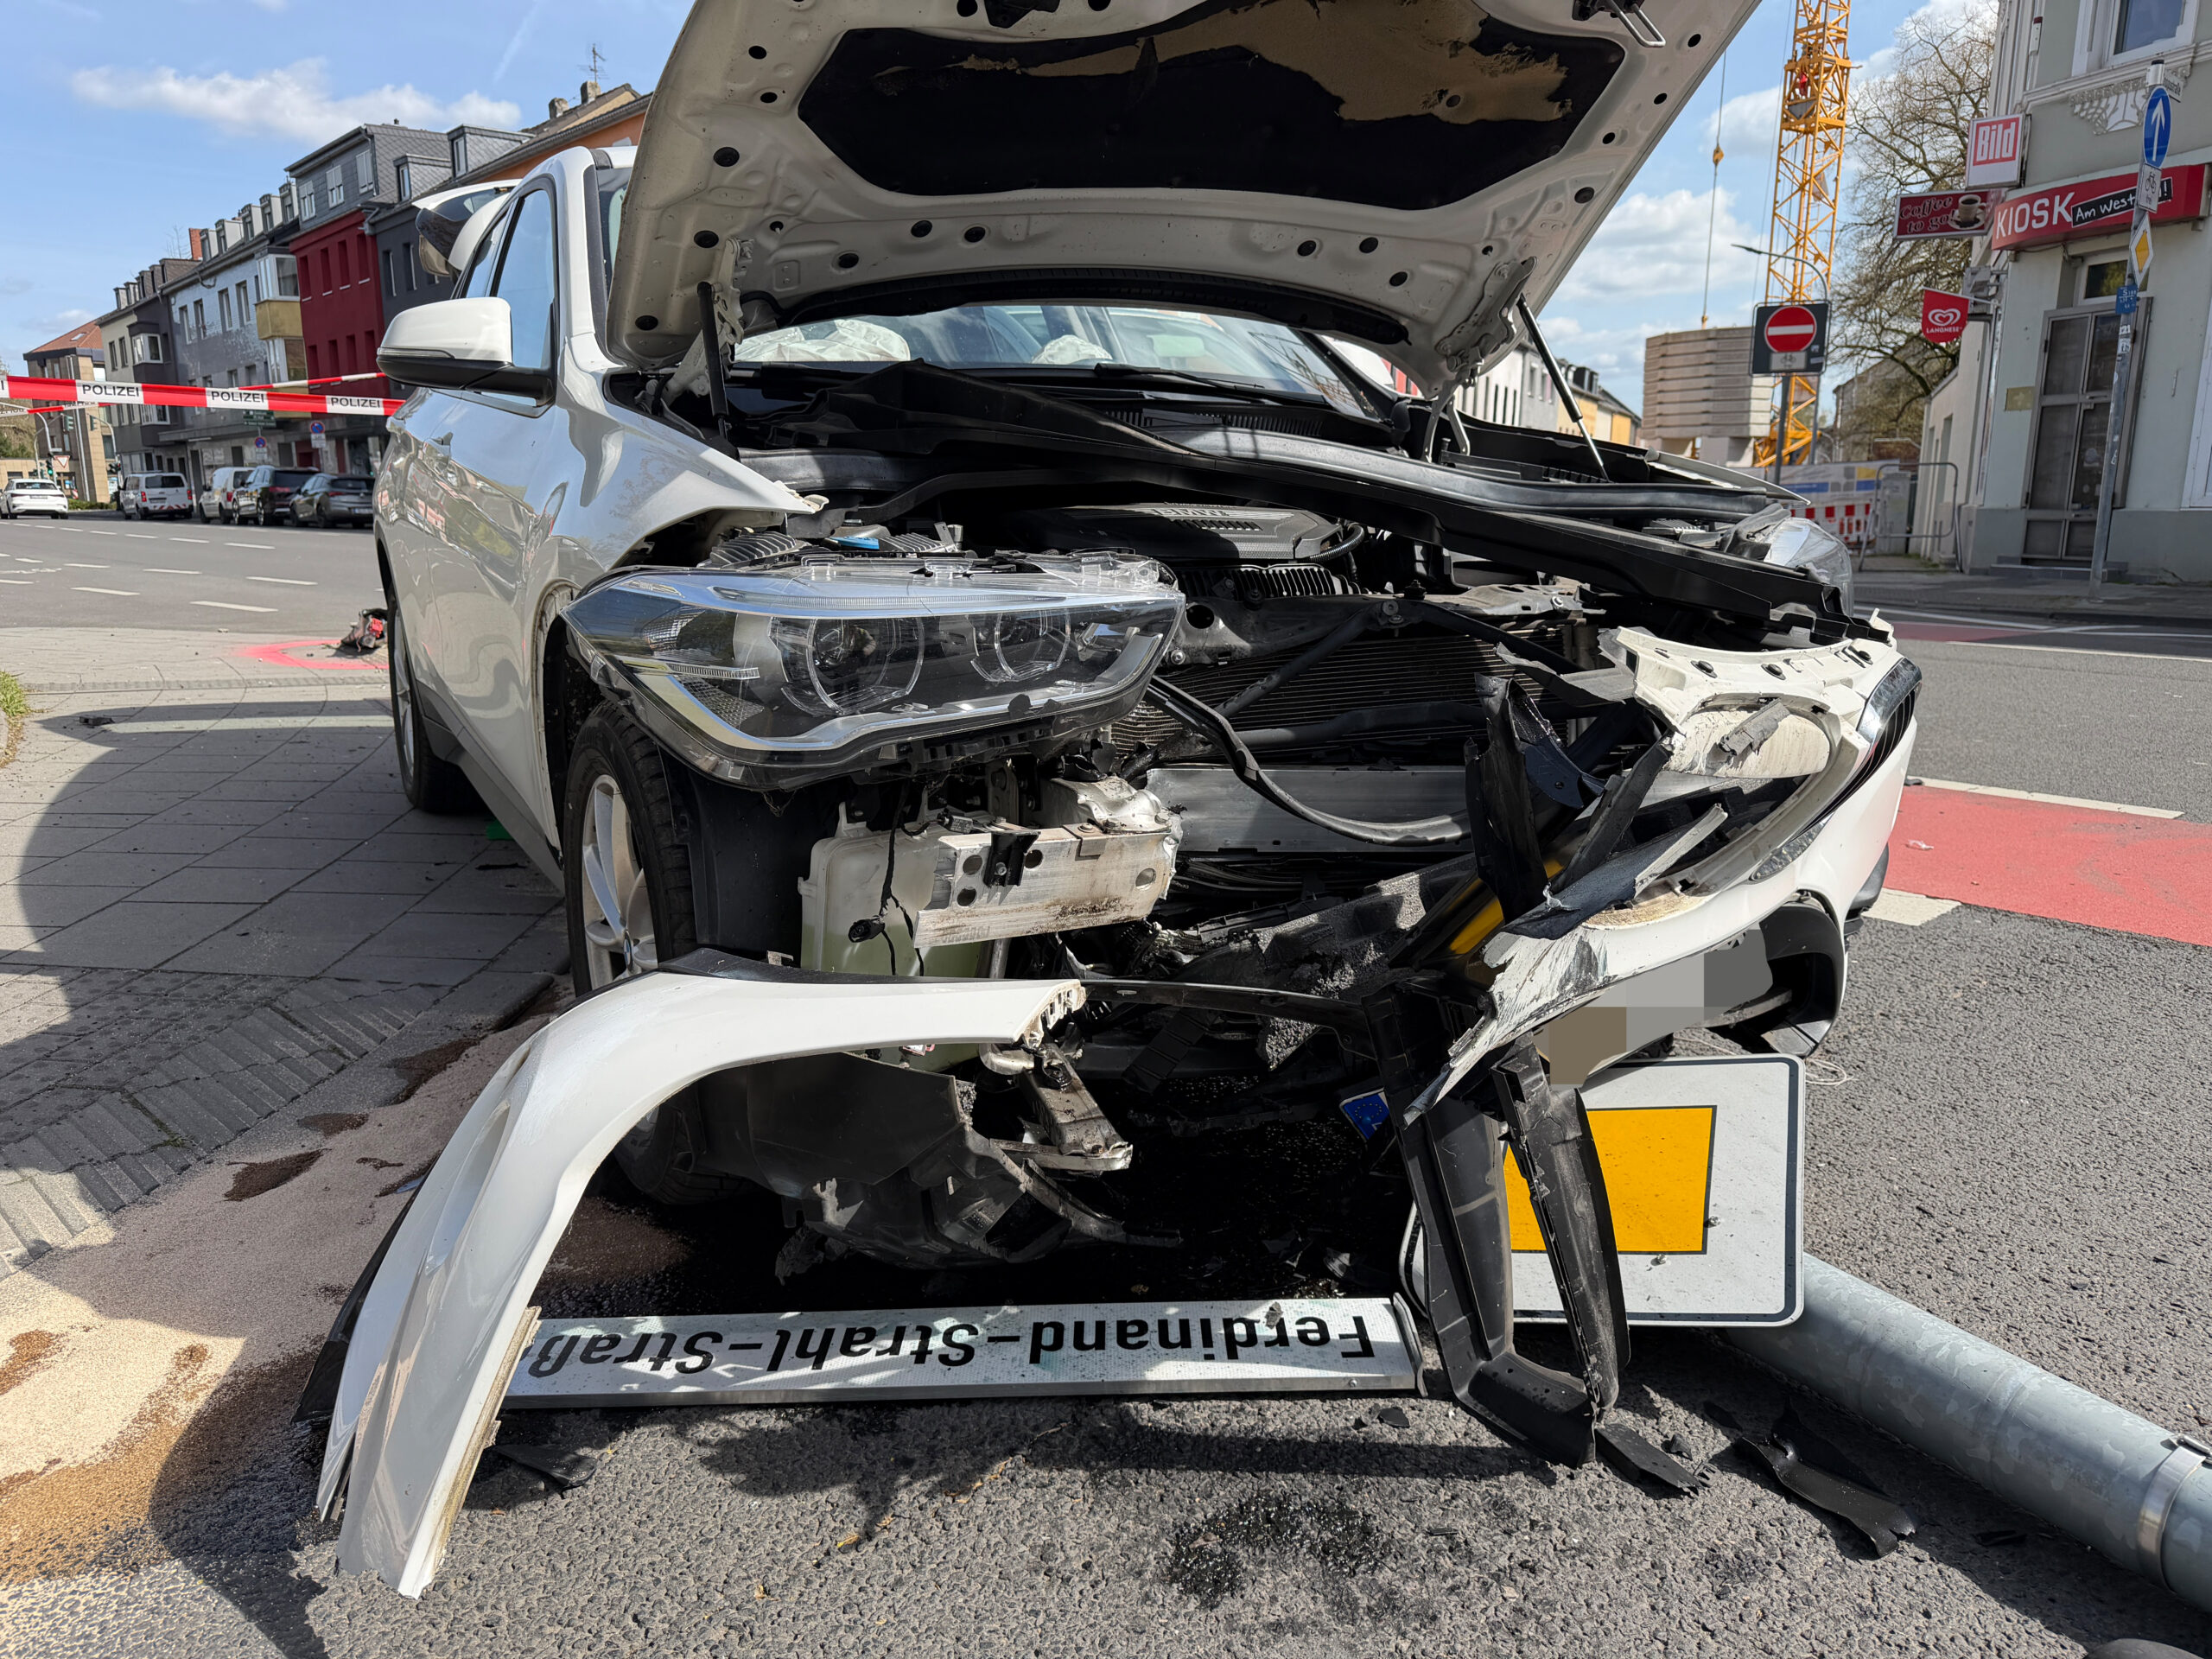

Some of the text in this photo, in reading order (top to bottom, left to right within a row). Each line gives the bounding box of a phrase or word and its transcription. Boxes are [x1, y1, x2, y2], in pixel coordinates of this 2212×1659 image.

[1976, 122, 2016, 162] Bild
[1900, 196, 1953, 219] Coffee
[1996, 192, 2075, 240] KIOSK
[2075, 206, 2096, 222] Am
[1907, 221, 1924, 233] to
[82, 385, 140, 397] POLIZEI
[211, 391, 264, 404] POLIZEI
[330, 397, 381, 409] POLIZEI
[519, 1316, 1376, 1378] Ferdinand-Strahl-Straß
